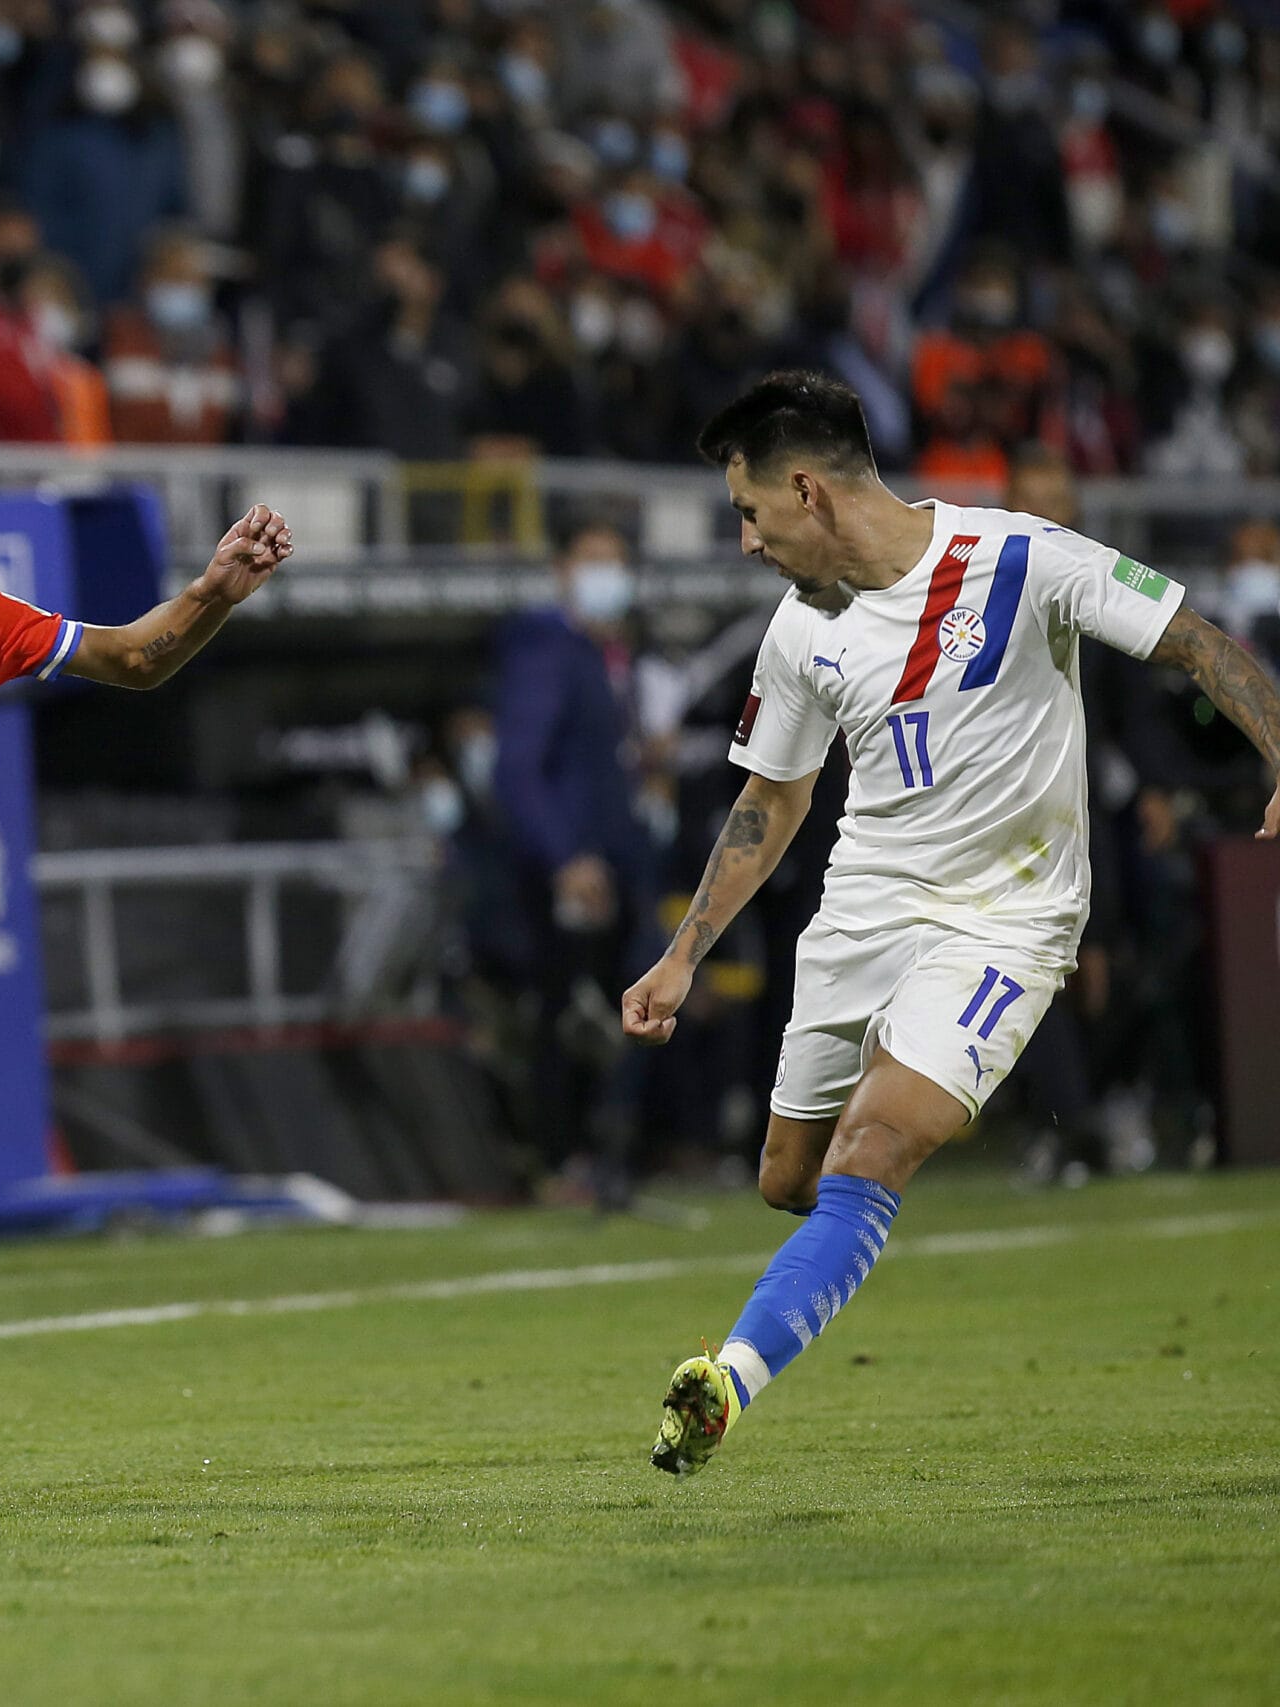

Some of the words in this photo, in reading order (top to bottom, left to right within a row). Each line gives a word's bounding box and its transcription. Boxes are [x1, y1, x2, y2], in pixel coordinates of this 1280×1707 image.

[951, 611, 967, 622] APF
[885, 711, 934, 788] 17
[957, 965, 1026, 1041] 17
